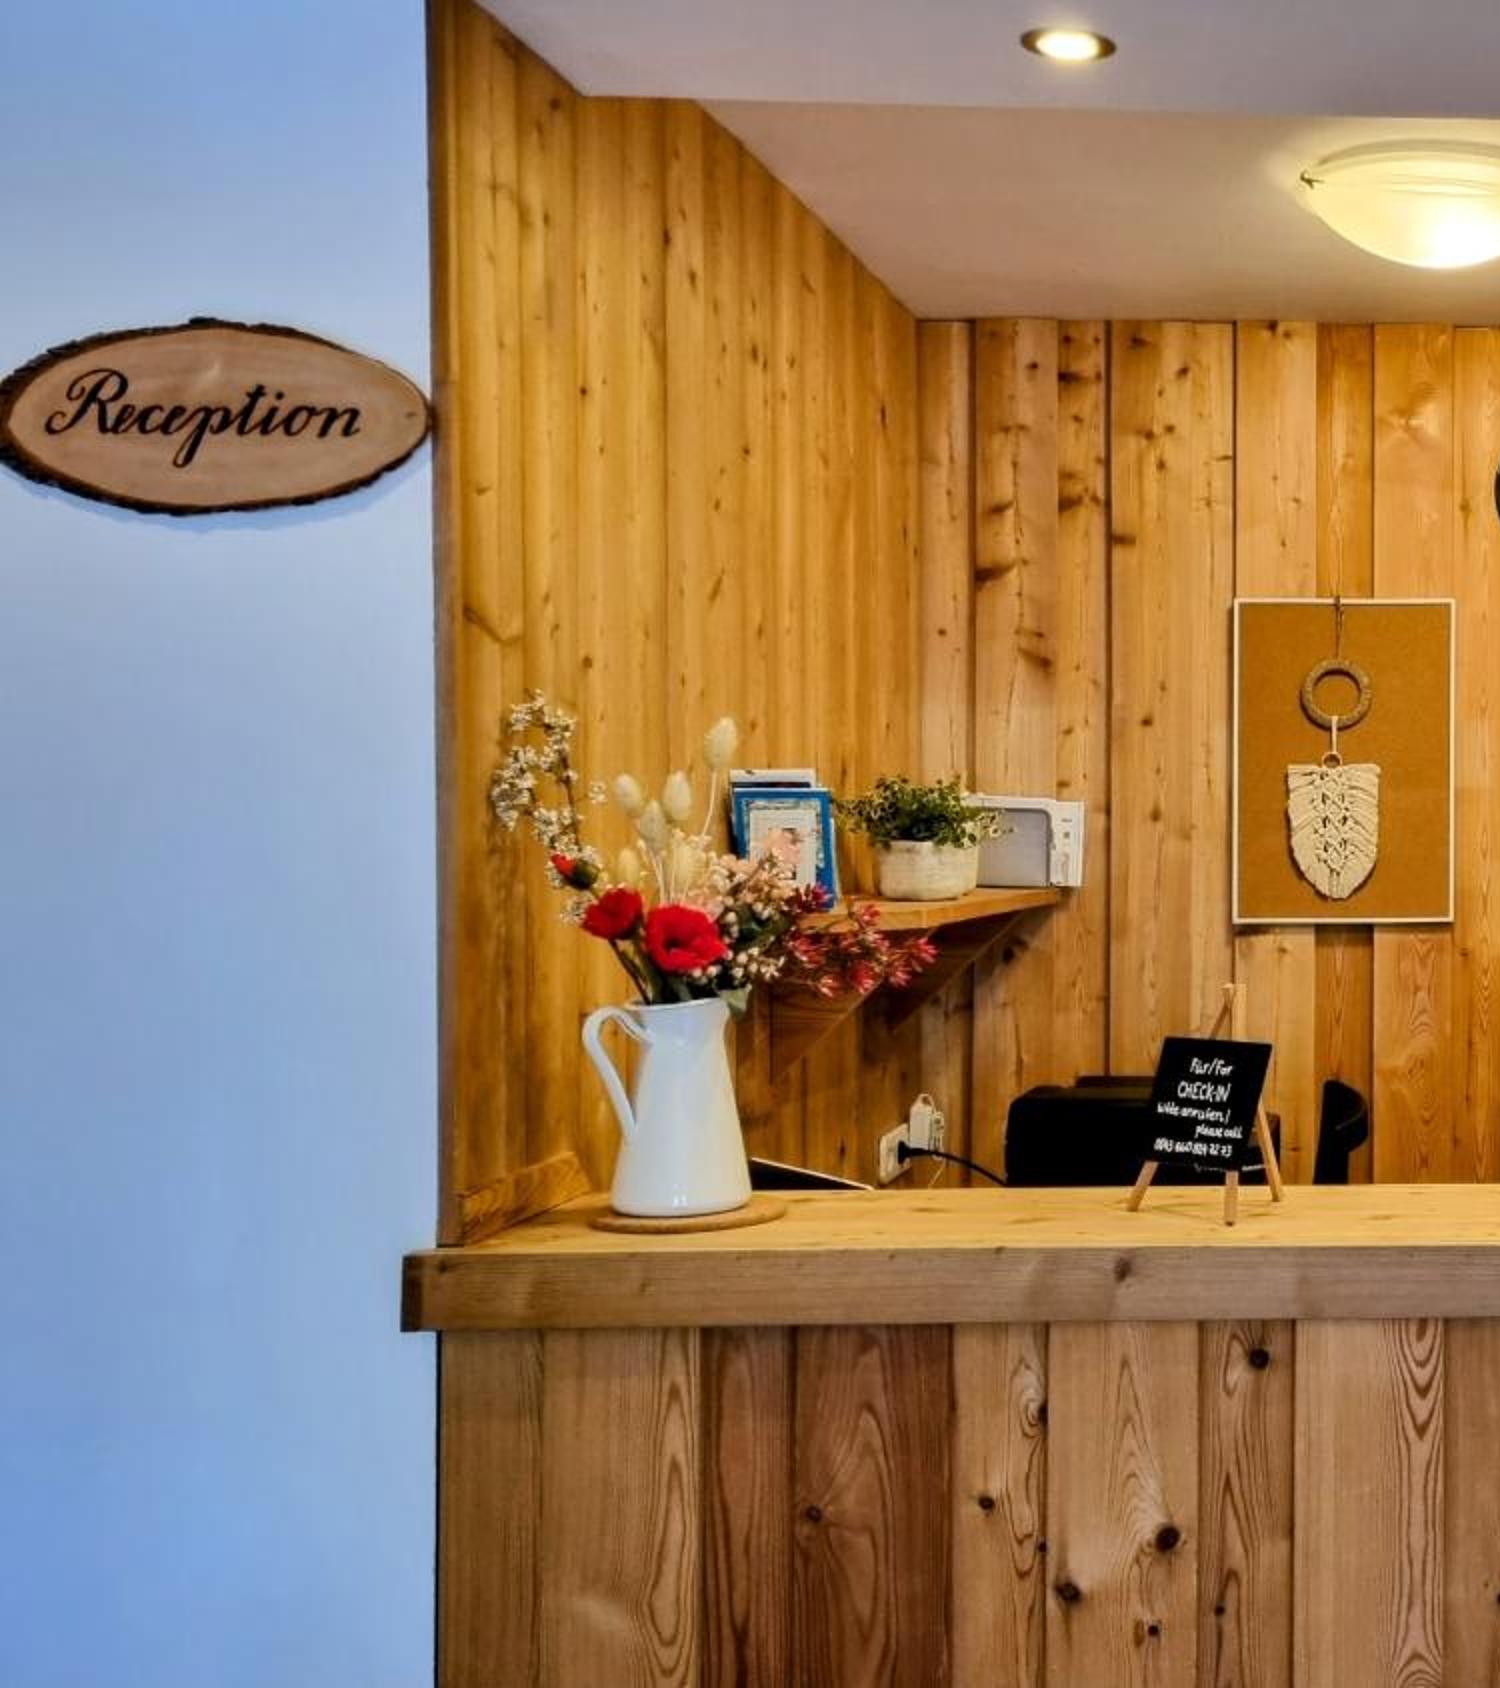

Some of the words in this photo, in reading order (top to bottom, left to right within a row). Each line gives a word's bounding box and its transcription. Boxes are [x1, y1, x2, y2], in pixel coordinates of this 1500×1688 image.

[45, 368, 361, 468] Reception
[1177, 1080, 1232, 1102] CHECK-IN
[1224, 1125, 1243, 1138] call
